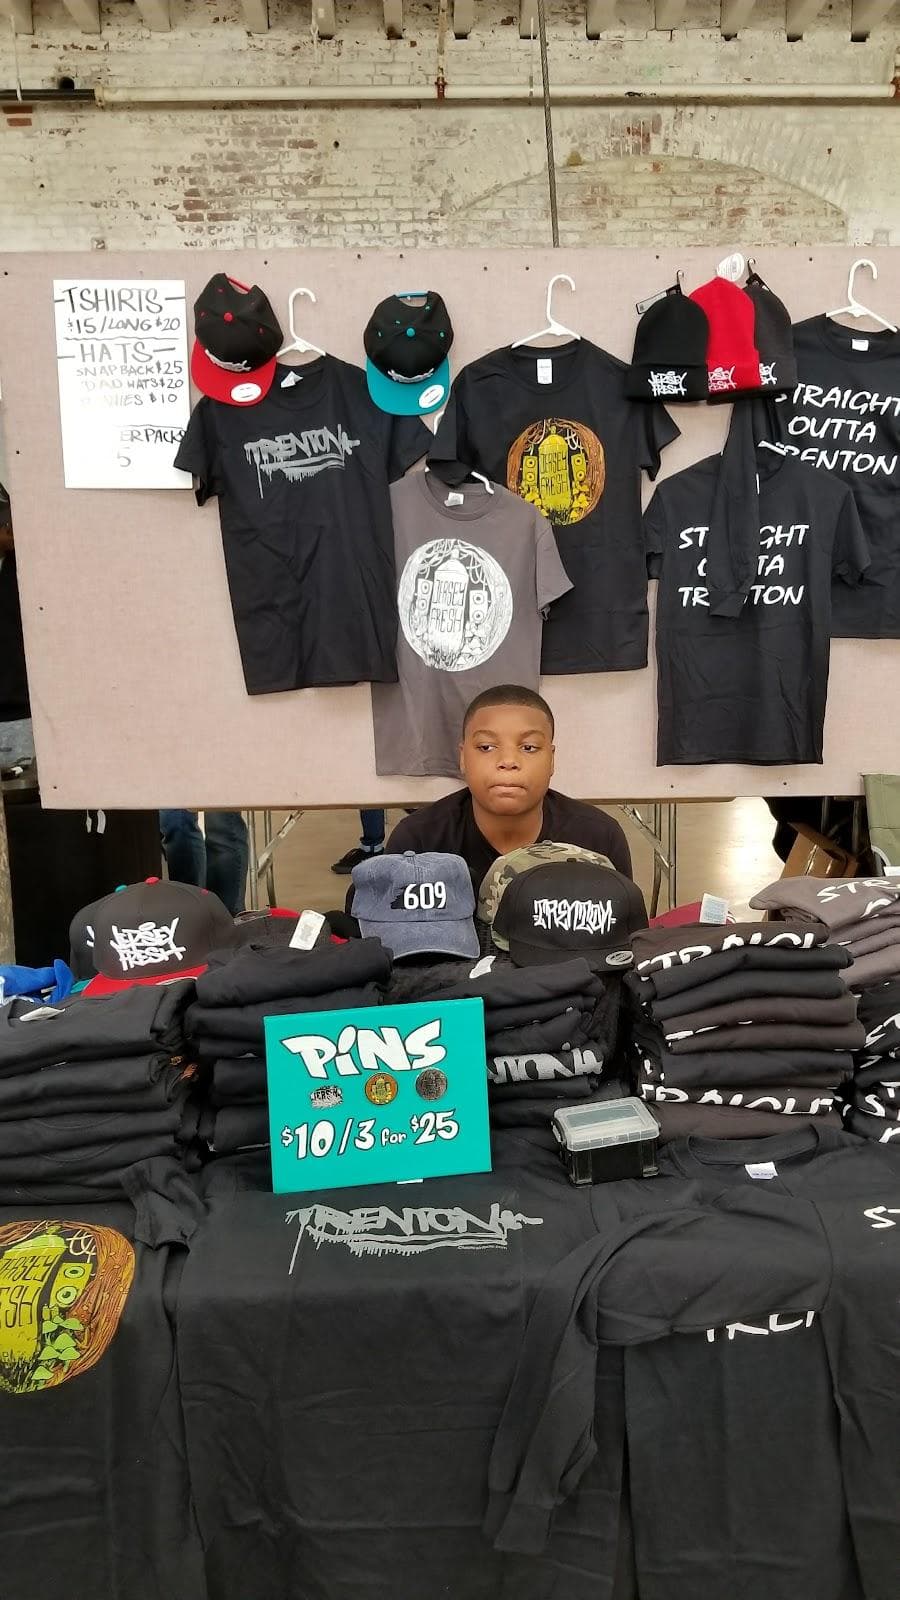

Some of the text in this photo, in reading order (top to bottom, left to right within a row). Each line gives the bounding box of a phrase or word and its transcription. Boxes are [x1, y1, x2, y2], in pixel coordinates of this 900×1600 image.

[62, 287, 164, 314] TSHIRTS
[155, 317, 181, 331] $20
[80, 341, 154, 363] HATS
[156, 360, 184, 375] $25
[81, 378, 123, 391] DAD
[158, 377, 184, 389] $20
[149, 392, 178, 404] $10
[788, 415, 876, 443] OUTTA
[541, 474, 569, 496] FRESH
[430, 608, 463, 633] FRESH
[403, 881, 446, 910] 609
[532, 899, 617, 934] TRENTON
[380, 1127, 407, 1147] for
[410, 1108, 460, 1145] $25
